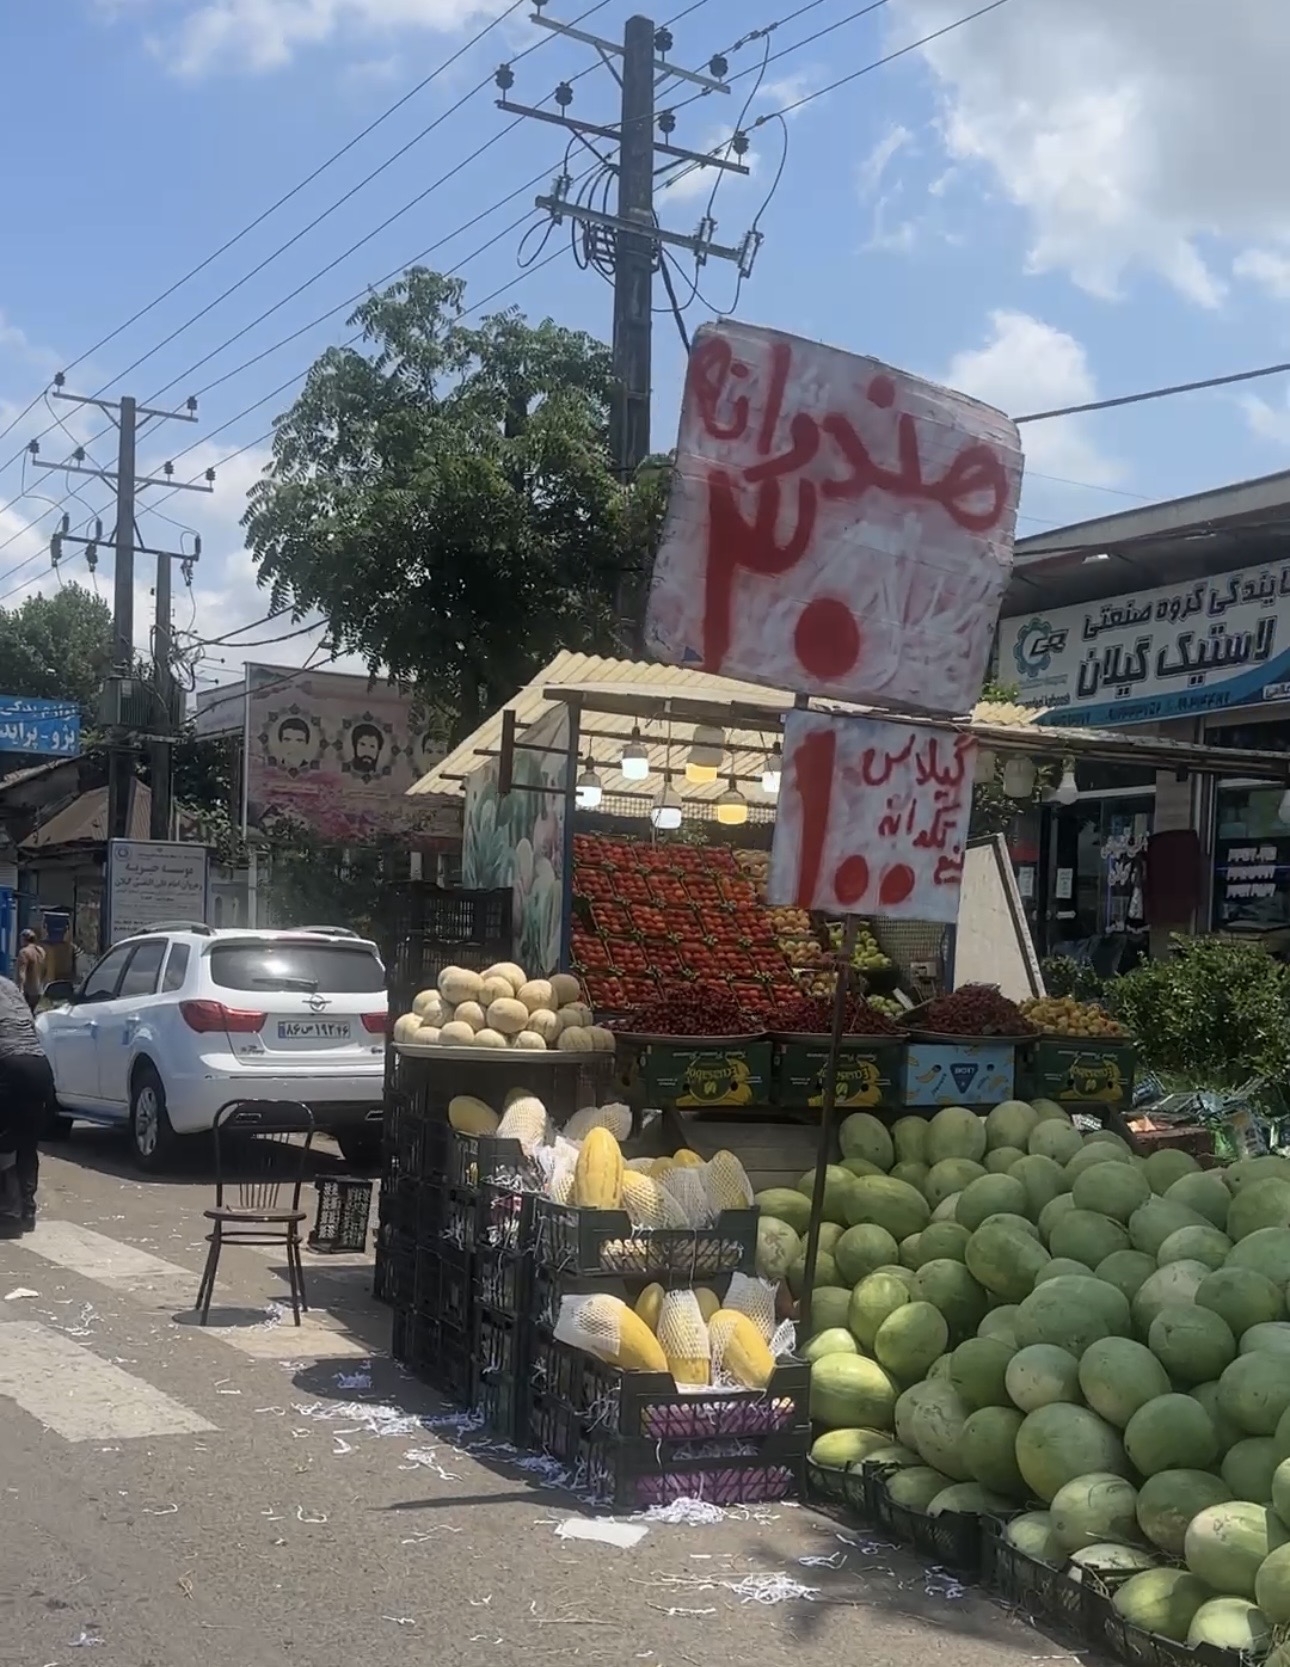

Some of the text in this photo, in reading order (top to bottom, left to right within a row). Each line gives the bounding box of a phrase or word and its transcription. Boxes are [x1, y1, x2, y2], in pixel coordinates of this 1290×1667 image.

[691, 336, 1008, 532] هندوانه
[1083, 567, 1290, 640] ایندگی گروه صنعتی
[1077, 616, 1277, 698] لاستیک گیلان
[51, 724, 75, 752] پژو
[862, 733, 979, 800] گیلاس
